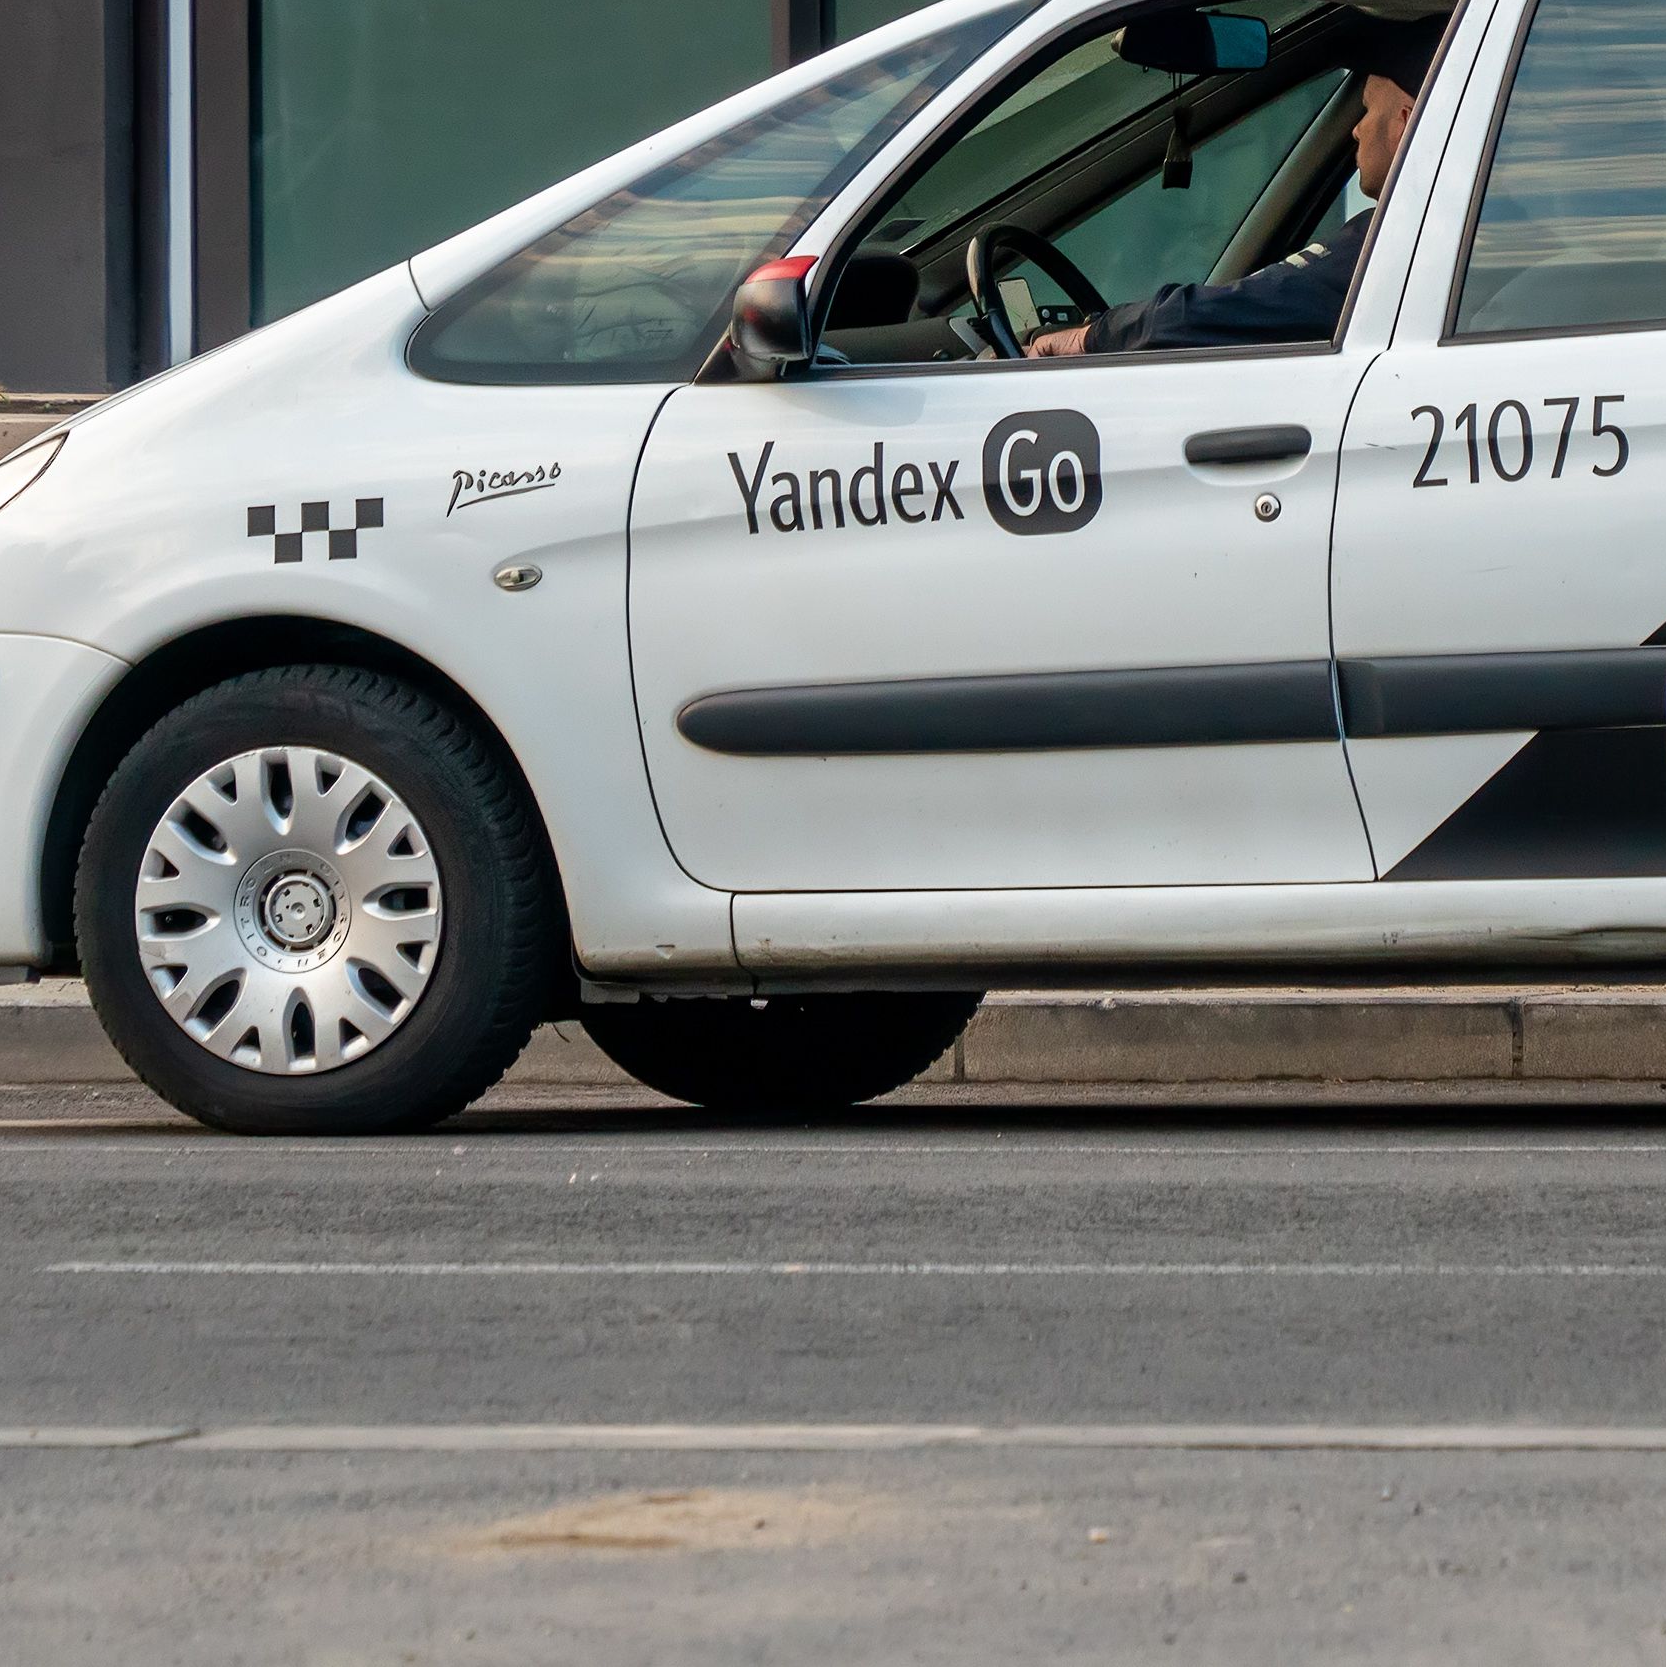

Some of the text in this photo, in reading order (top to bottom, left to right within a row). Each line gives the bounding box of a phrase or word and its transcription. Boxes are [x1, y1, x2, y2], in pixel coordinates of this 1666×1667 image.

[727, 428, 1087, 535] Yandex Go
[1410, 394, 1630, 489] 21075
